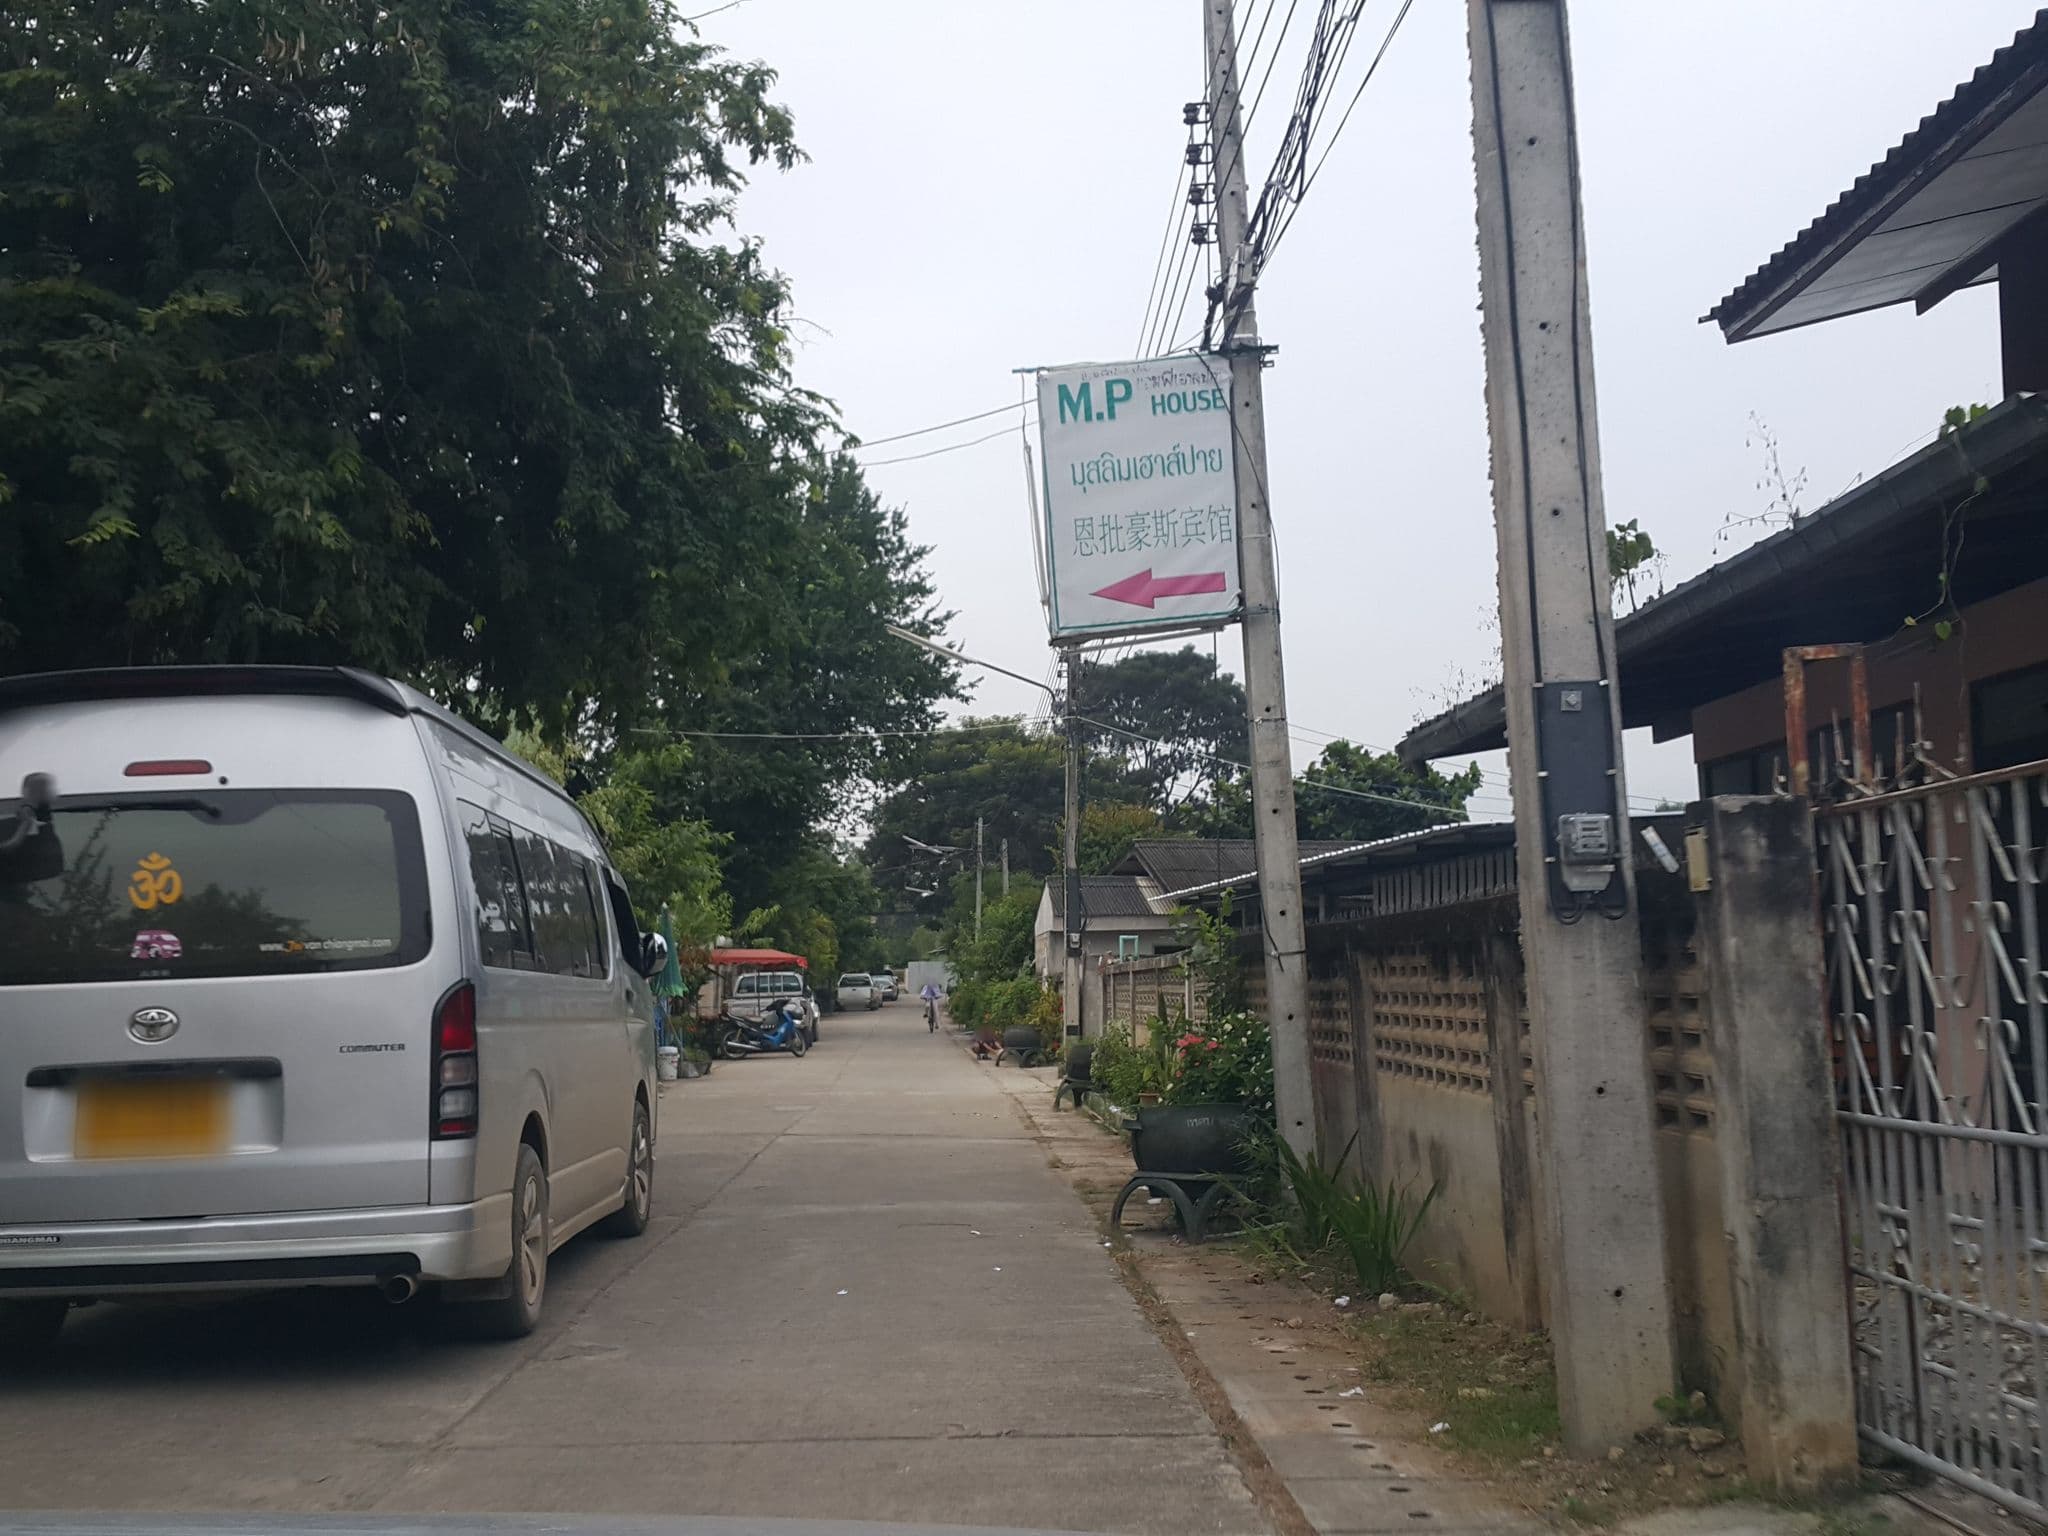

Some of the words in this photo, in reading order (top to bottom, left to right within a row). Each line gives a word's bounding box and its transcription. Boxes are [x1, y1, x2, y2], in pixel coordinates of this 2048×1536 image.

[1057, 378, 1133, 424] M.P
[1151, 389, 1226, 416] HOUSE
[1071, 443, 1223, 494] มุสลิมเฮาส์ปาย
[1073, 504, 1233, 557] 恩批豪斯宾馆
[339, 1043, 405, 1053] COMMUTER
